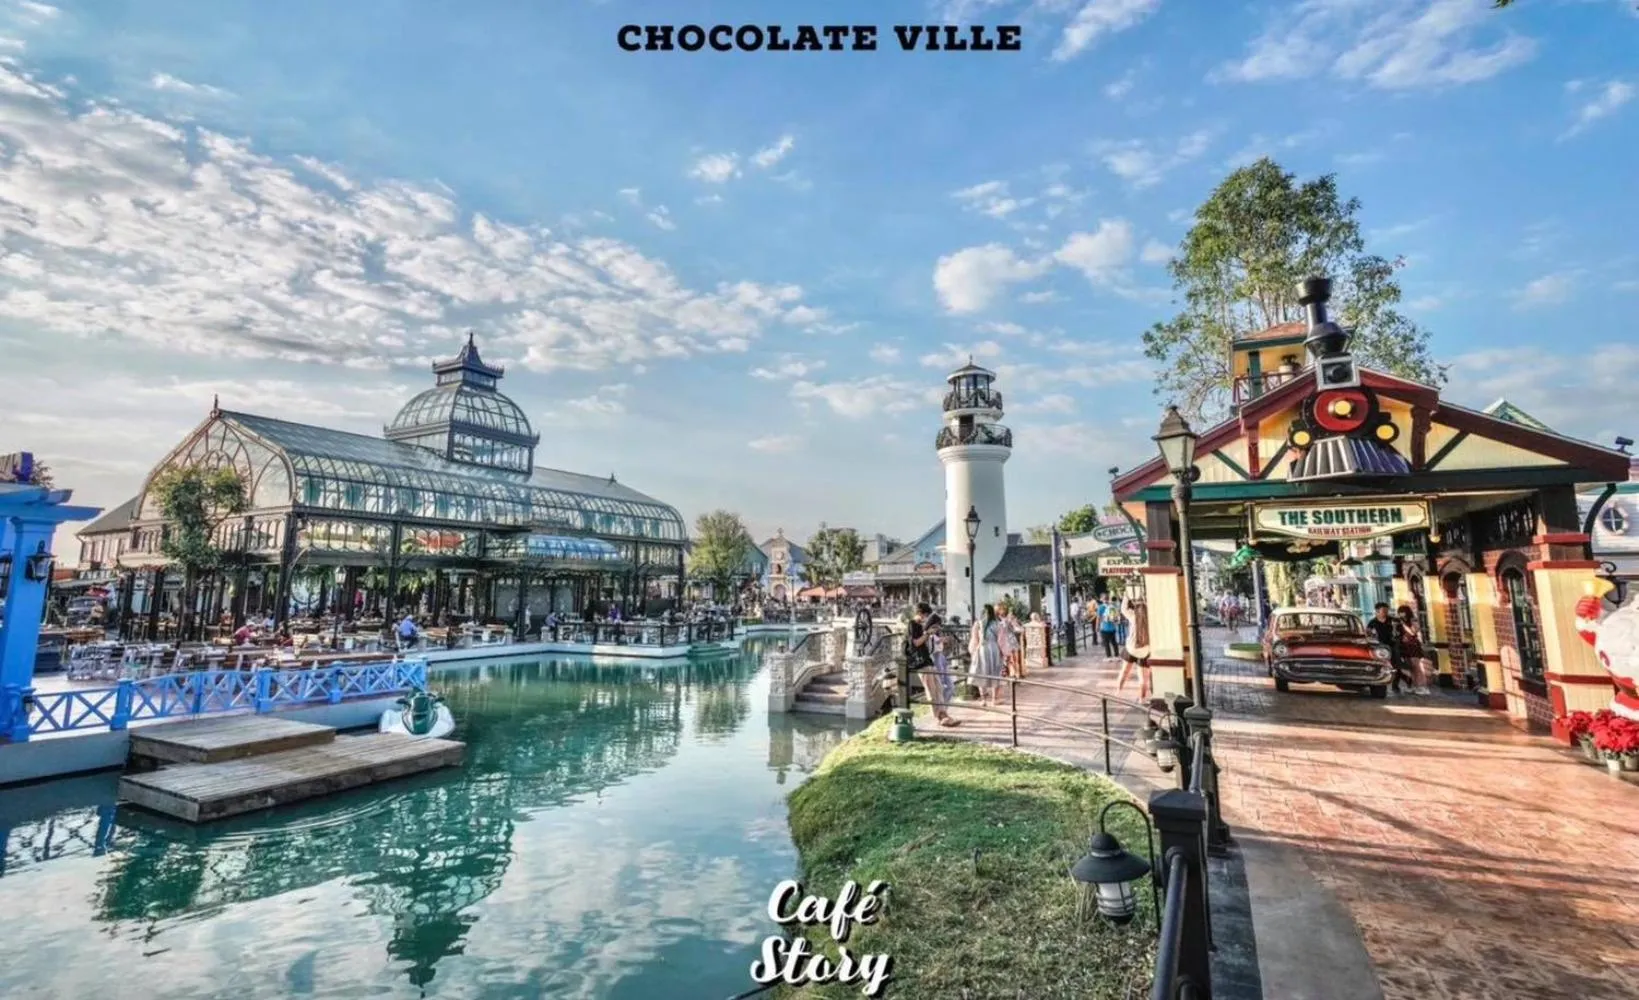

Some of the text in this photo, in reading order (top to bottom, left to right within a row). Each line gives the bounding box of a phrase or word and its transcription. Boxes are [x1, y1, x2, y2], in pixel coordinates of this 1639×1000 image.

[1278, 508, 1402, 525] THE SOUTHERN
[1308, 526, 1371, 535] RAILWAY STATION
